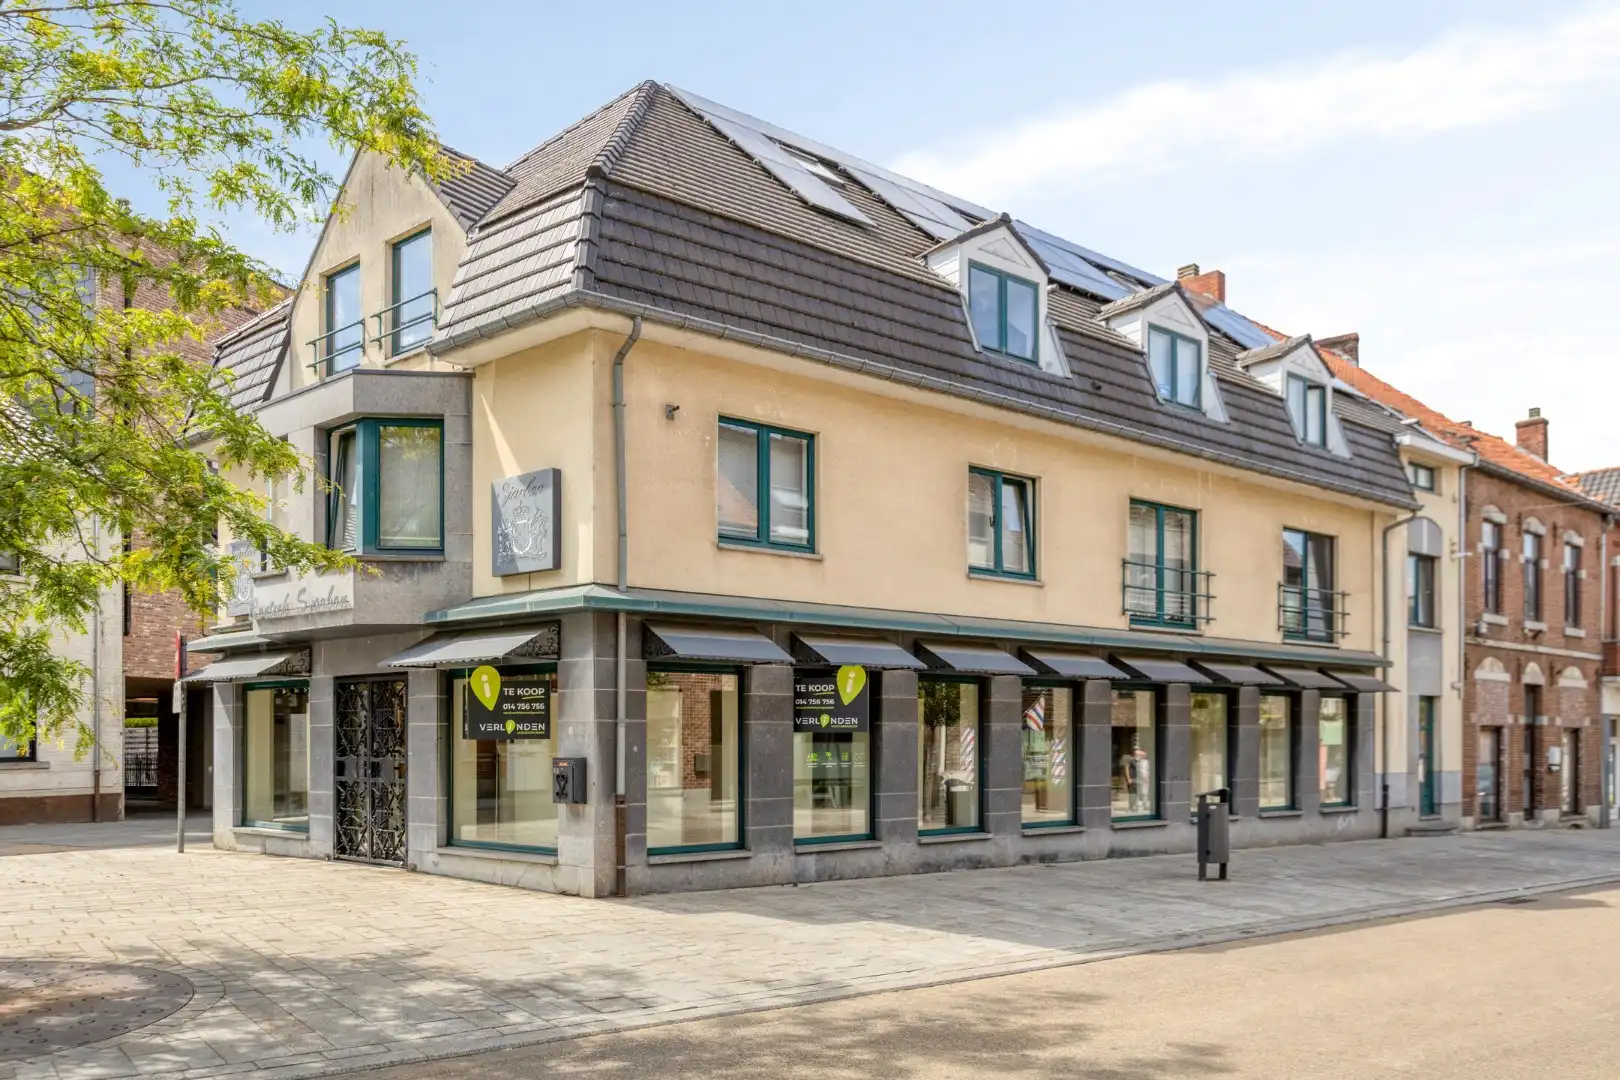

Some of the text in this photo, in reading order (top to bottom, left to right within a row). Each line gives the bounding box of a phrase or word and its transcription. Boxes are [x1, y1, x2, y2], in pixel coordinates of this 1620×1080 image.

[503, 687, 545, 696] TE KOOP
[795, 684, 835, 692] TE KOOP
